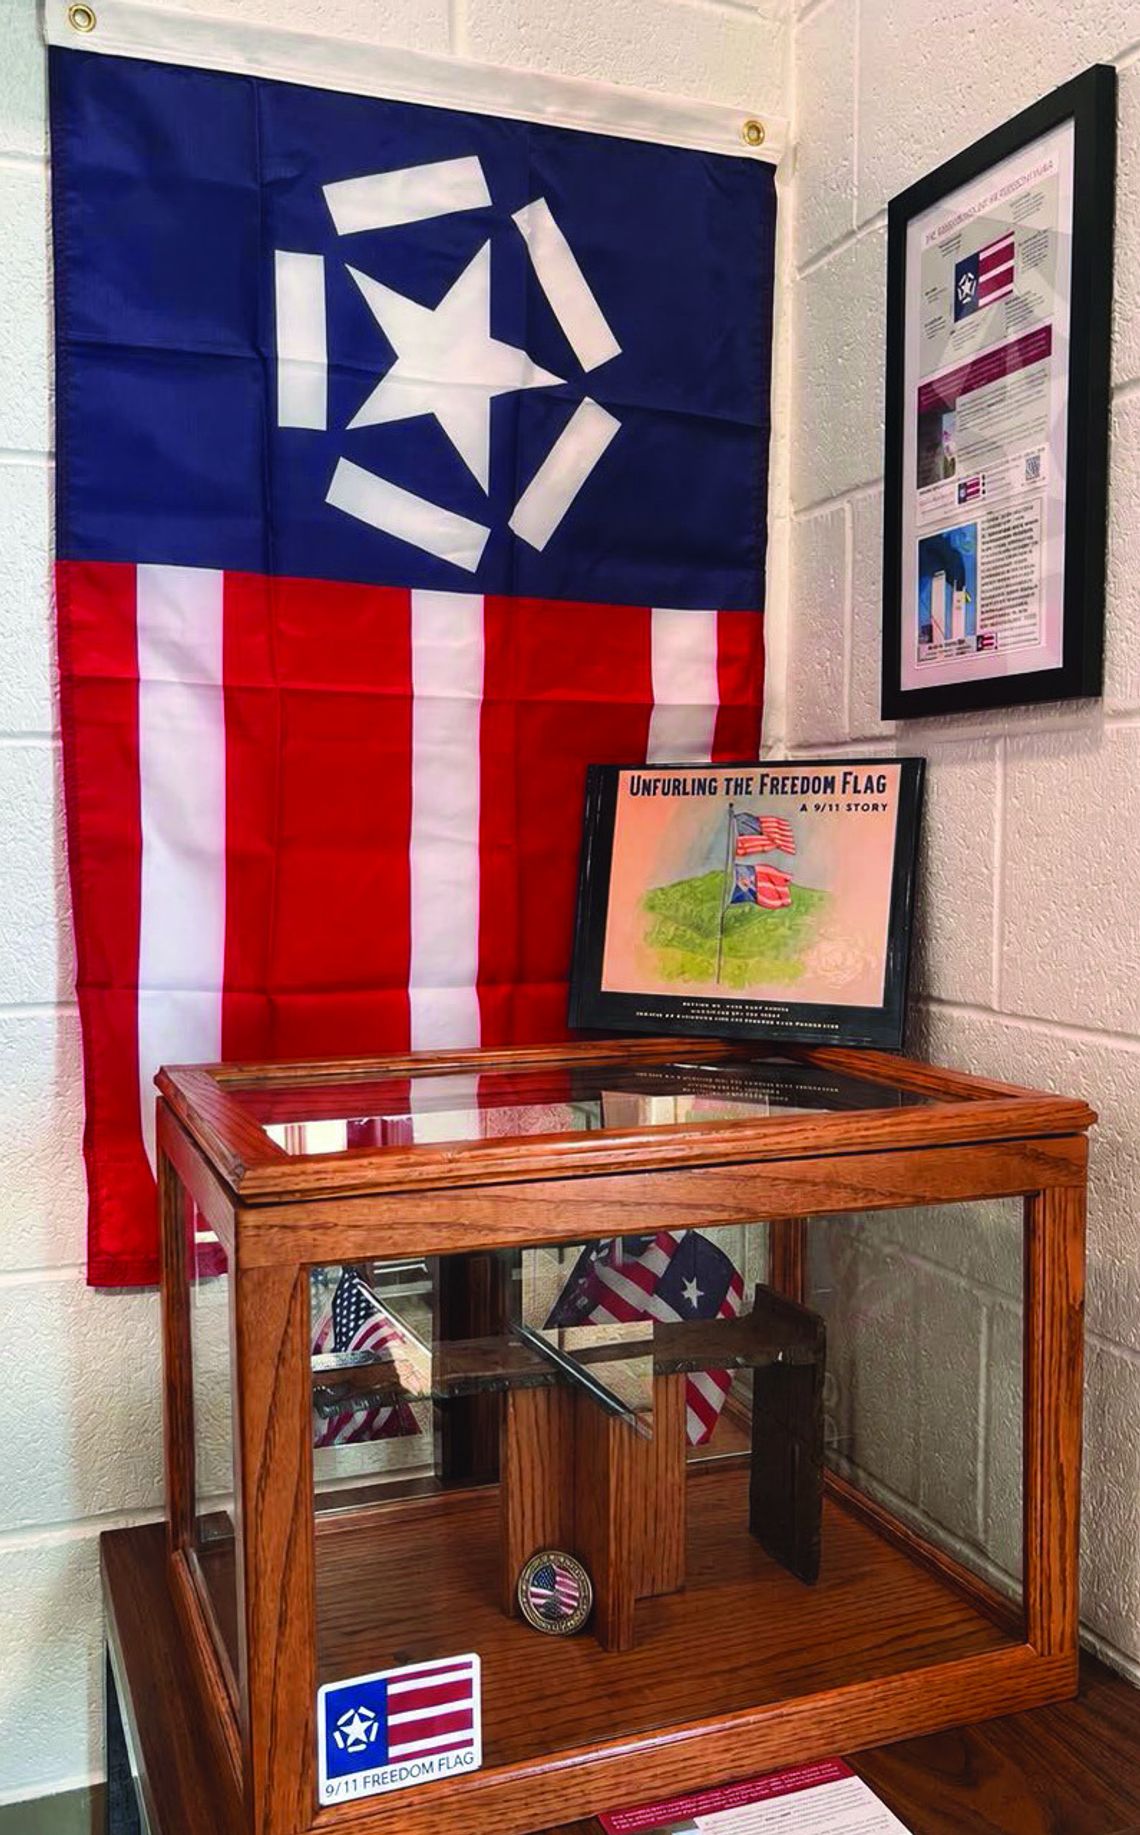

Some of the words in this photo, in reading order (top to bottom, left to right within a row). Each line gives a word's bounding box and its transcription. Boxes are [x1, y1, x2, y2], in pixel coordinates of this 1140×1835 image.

[630, 775, 718, 796] UNFURLING
[724, 777, 754, 796] THE
[759, 773, 836, 796] FREEDOM
[841, 771, 887, 794] FLAG
[799, 804, 808, 812] A
[814, 803, 839, 812] 9/11
[846, 803, 888, 812] STORY
[325, 1778, 358, 1798] 9/11
[362, 1761, 434, 1789] FREEDOM
[438, 1751, 475, 1772] FLAG
